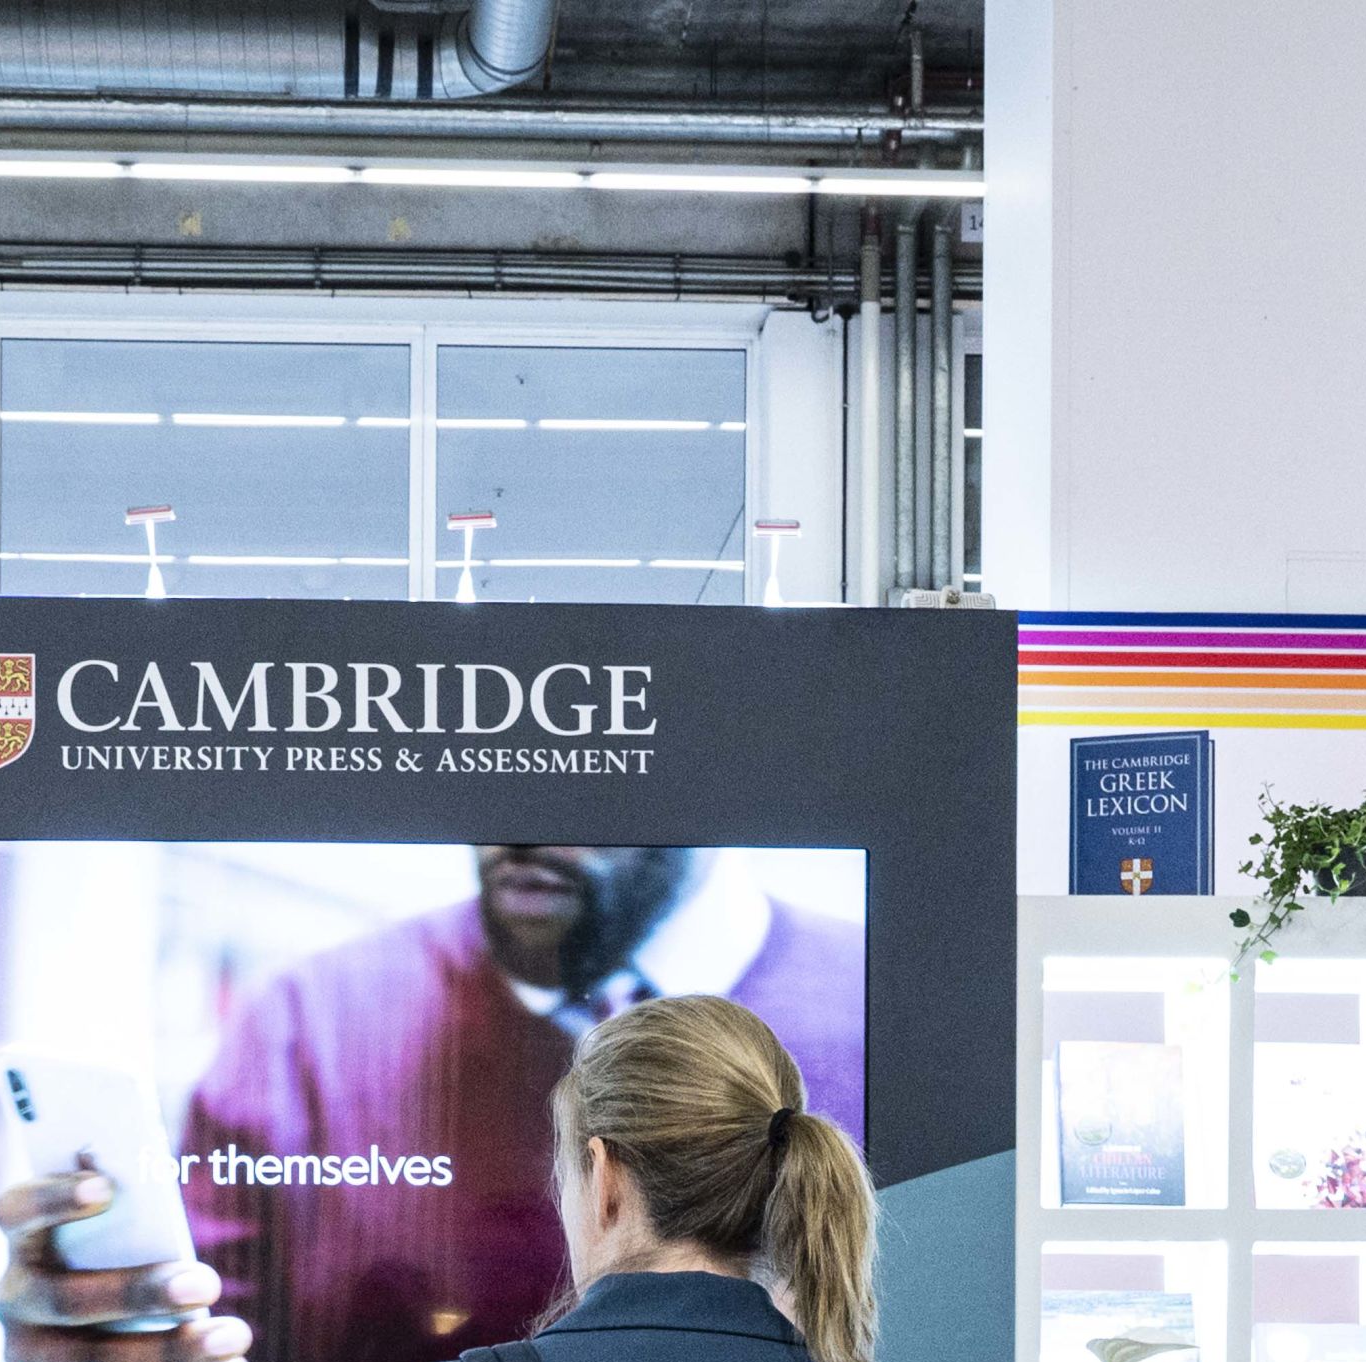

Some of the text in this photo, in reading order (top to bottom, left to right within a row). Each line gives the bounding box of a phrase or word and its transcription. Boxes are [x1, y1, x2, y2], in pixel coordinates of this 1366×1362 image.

[56, 659, 658, 736] CAMBRIDGE
[61, 745, 655, 775] UNIVERSITY PRESS & ASSESSMENT
[1084, 754, 1191, 771] THE CAMBRIDGE
[1100, 770, 1176, 794] GREEK
[1087, 793, 1188, 817] LEXICON
[1111, 825, 1162, 836] VOLUME II
[208, 1144, 453, 1186] themselves
[1079, 1165, 1166, 1180] LITERATURE
